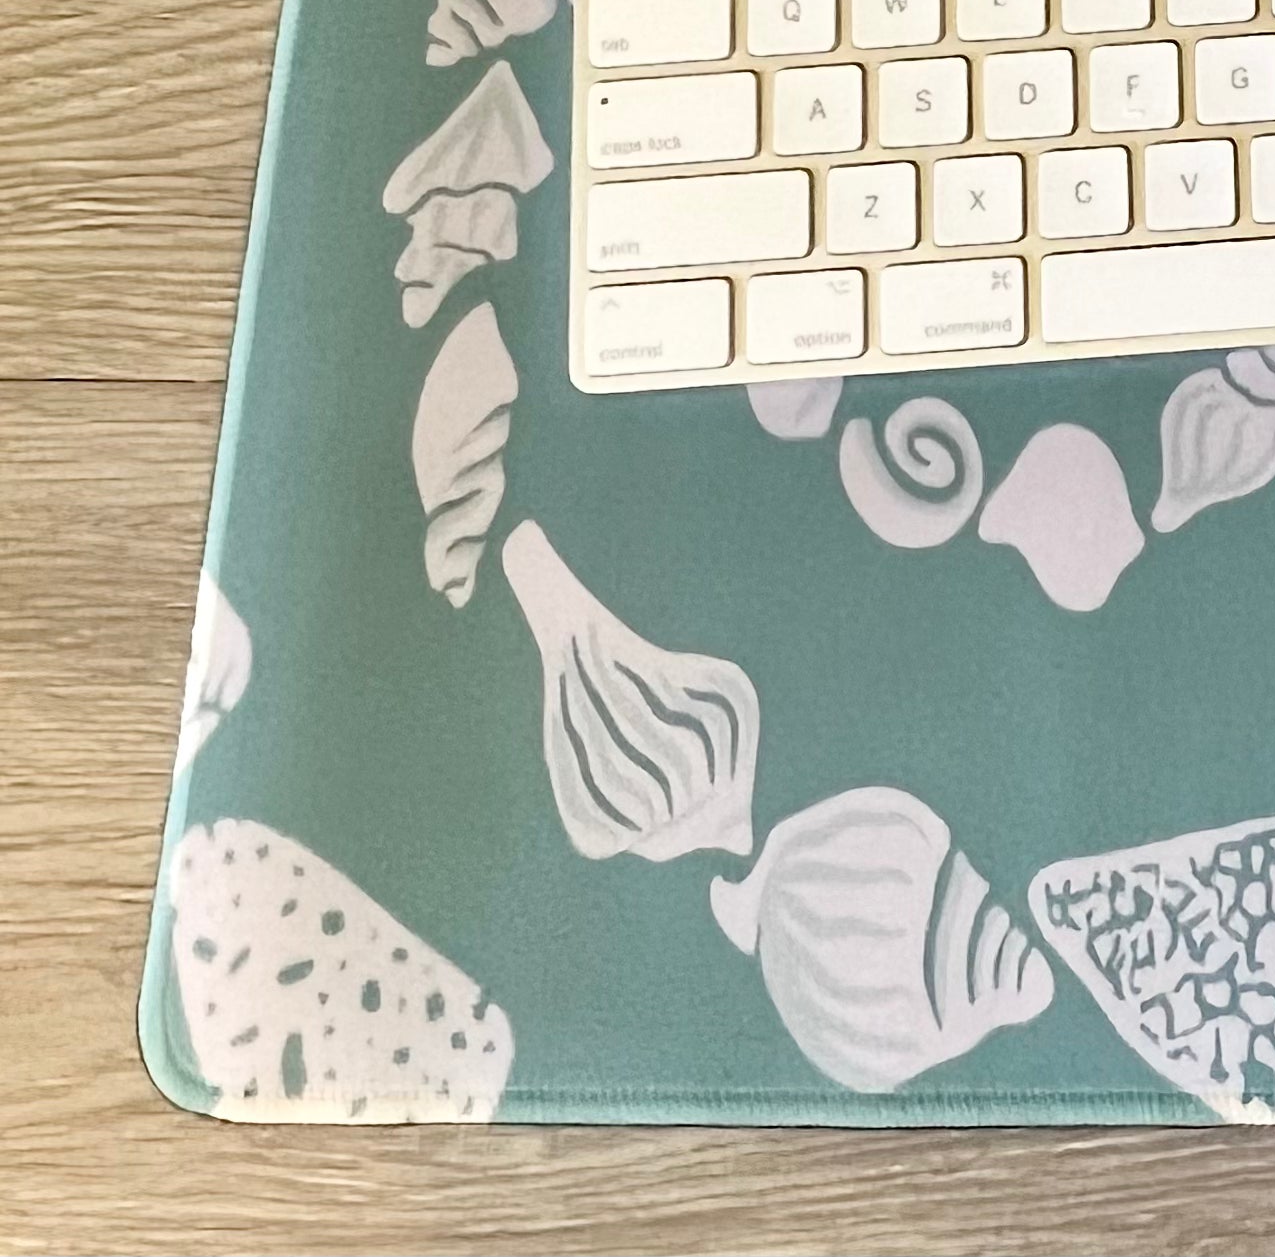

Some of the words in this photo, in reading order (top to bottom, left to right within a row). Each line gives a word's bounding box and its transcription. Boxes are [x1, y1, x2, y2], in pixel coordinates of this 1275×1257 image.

[1126, 73, 1140, 99] F
[1230, 66, 1250, 90] G
[914, 88, 932, 113] S
[1018, 81, 1038, 106] D
[808, 97, 827, 122] A
[1074, 180, 1093, 204] C
[1179, 172, 1199, 196] V
[863, 194, 879, 219] Z
[969, 189, 987, 212] X
